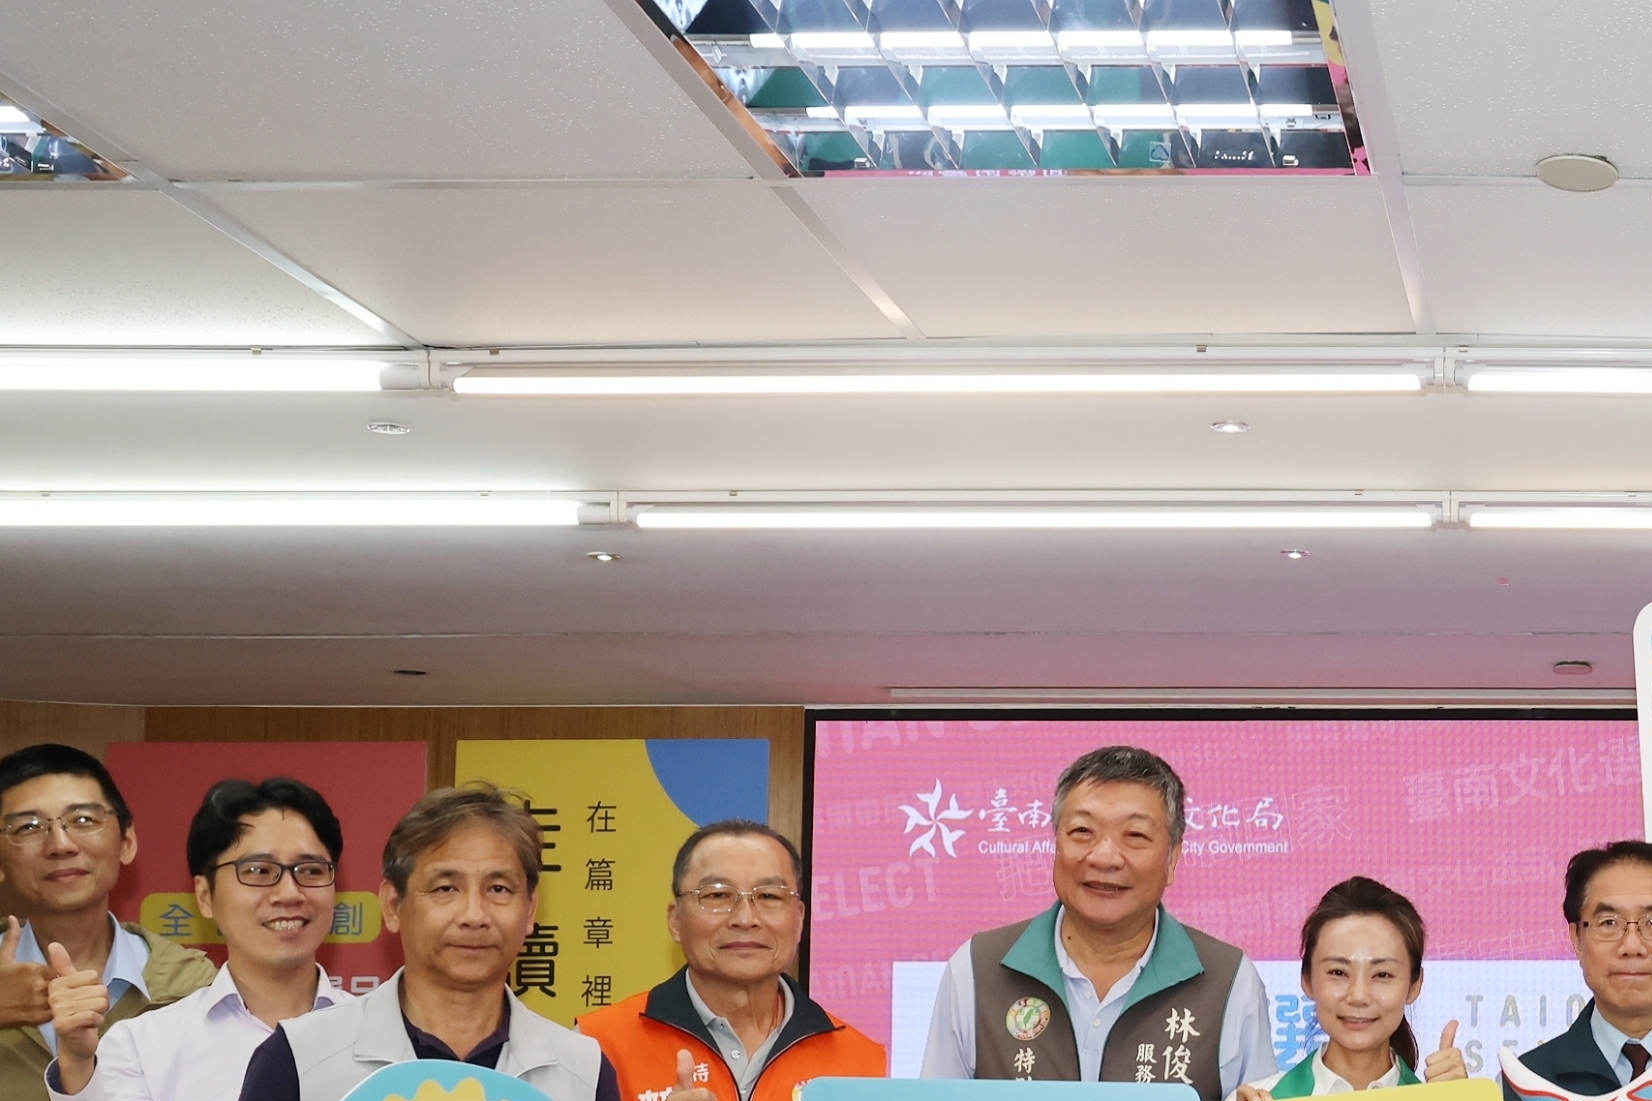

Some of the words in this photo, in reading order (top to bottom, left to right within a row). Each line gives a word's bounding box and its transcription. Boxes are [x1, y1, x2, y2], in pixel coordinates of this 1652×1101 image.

[978, 786, 1284, 833] 臺南文化局
[978, 840, 1029, 854] Cultural
[1032, 840, 1056, 854] Affa
[1181, 840, 1204, 856] City
[1208, 840, 1288, 854] Government
[580, 800, 617, 1007] 在篇章裡
[812, 857, 940, 922] ELECT
